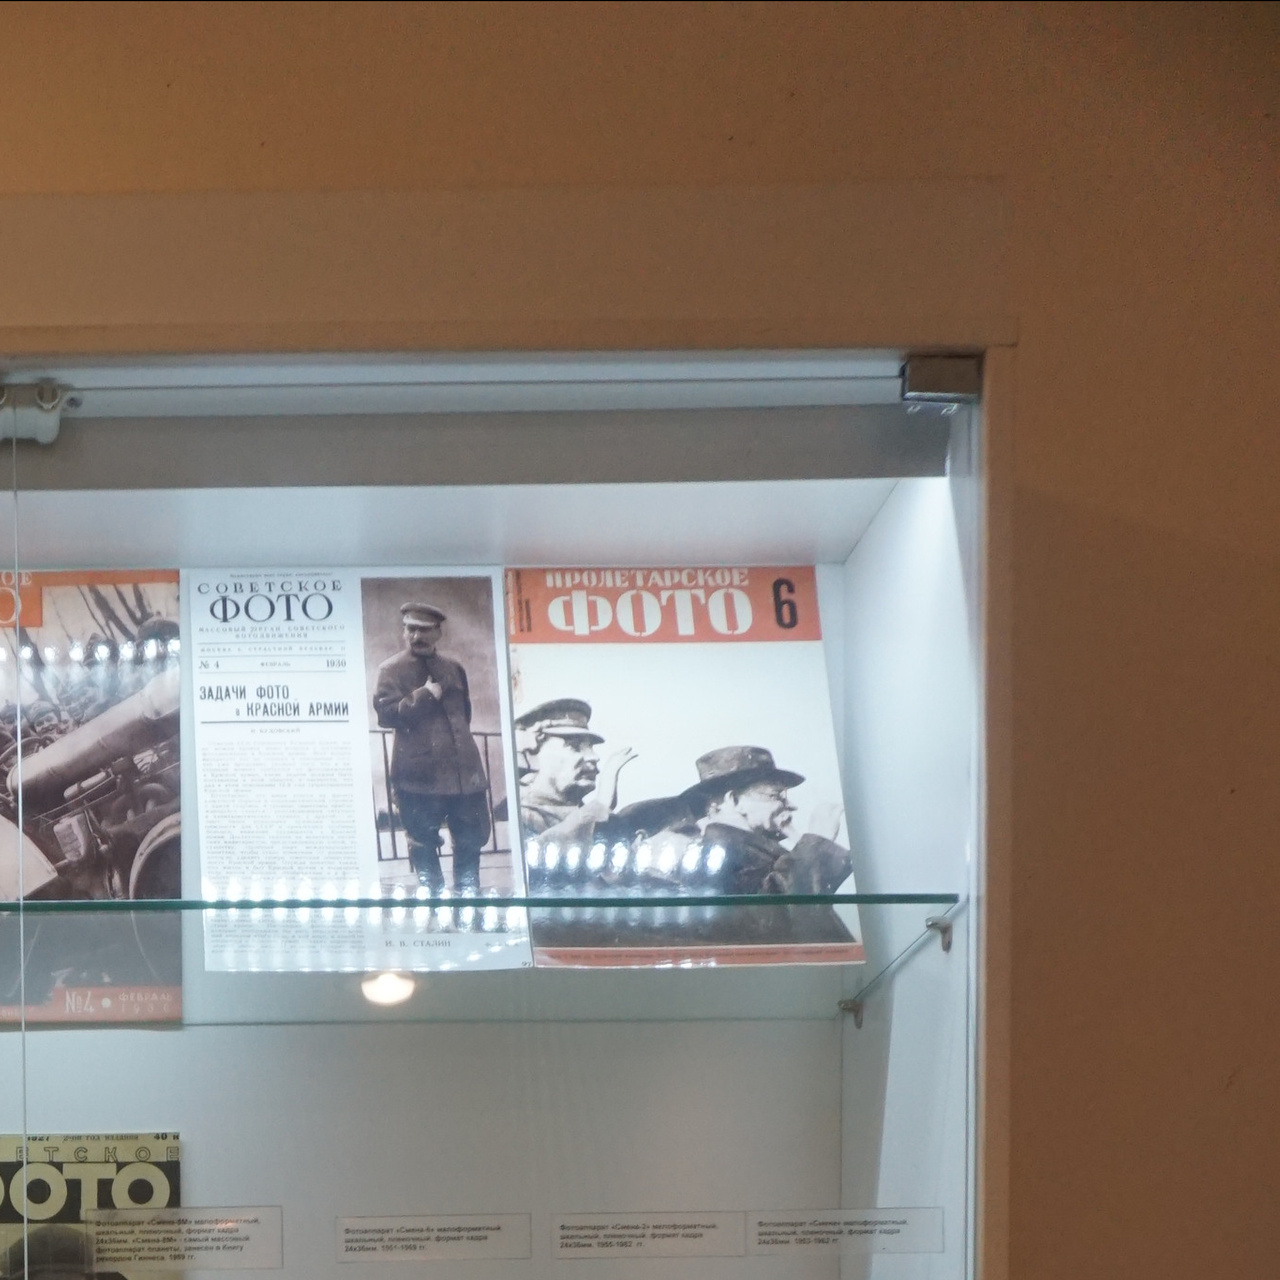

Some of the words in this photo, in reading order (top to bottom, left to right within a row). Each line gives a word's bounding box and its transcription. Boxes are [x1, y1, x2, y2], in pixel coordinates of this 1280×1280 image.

[197, 580, 342, 594] СОВЕТСКОЕ
[546, 568, 749, 588] ПРОЛЕТАРСКОЕ
[773, 578, 798, 629] 6
[210, 593, 333, 623] ФОТО
[548, 588, 752, 637] ФОТО
[199, 625, 246, 634] МАССОВЫЙ
[288, 624, 345, 632] СОВЕТСКОГО
[199, 660, 209, 670] №
[214, 660, 219, 669] 4
[326, 659, 346, 668] 1930
[200, 686, 246, 701] ЗАДАЧИ
[256, 685, 289, 699] ФОТО
[247, 702, 300, 717] КРАСНОЙ
[309, 702, 349, 716] АРМИИ
[385, 939, 394, 948] И.
[413, 938, 451, 948] СТАЛИН
[65, 991, 94, 1014] №4
[154, 1133, 168, 1141] 40
